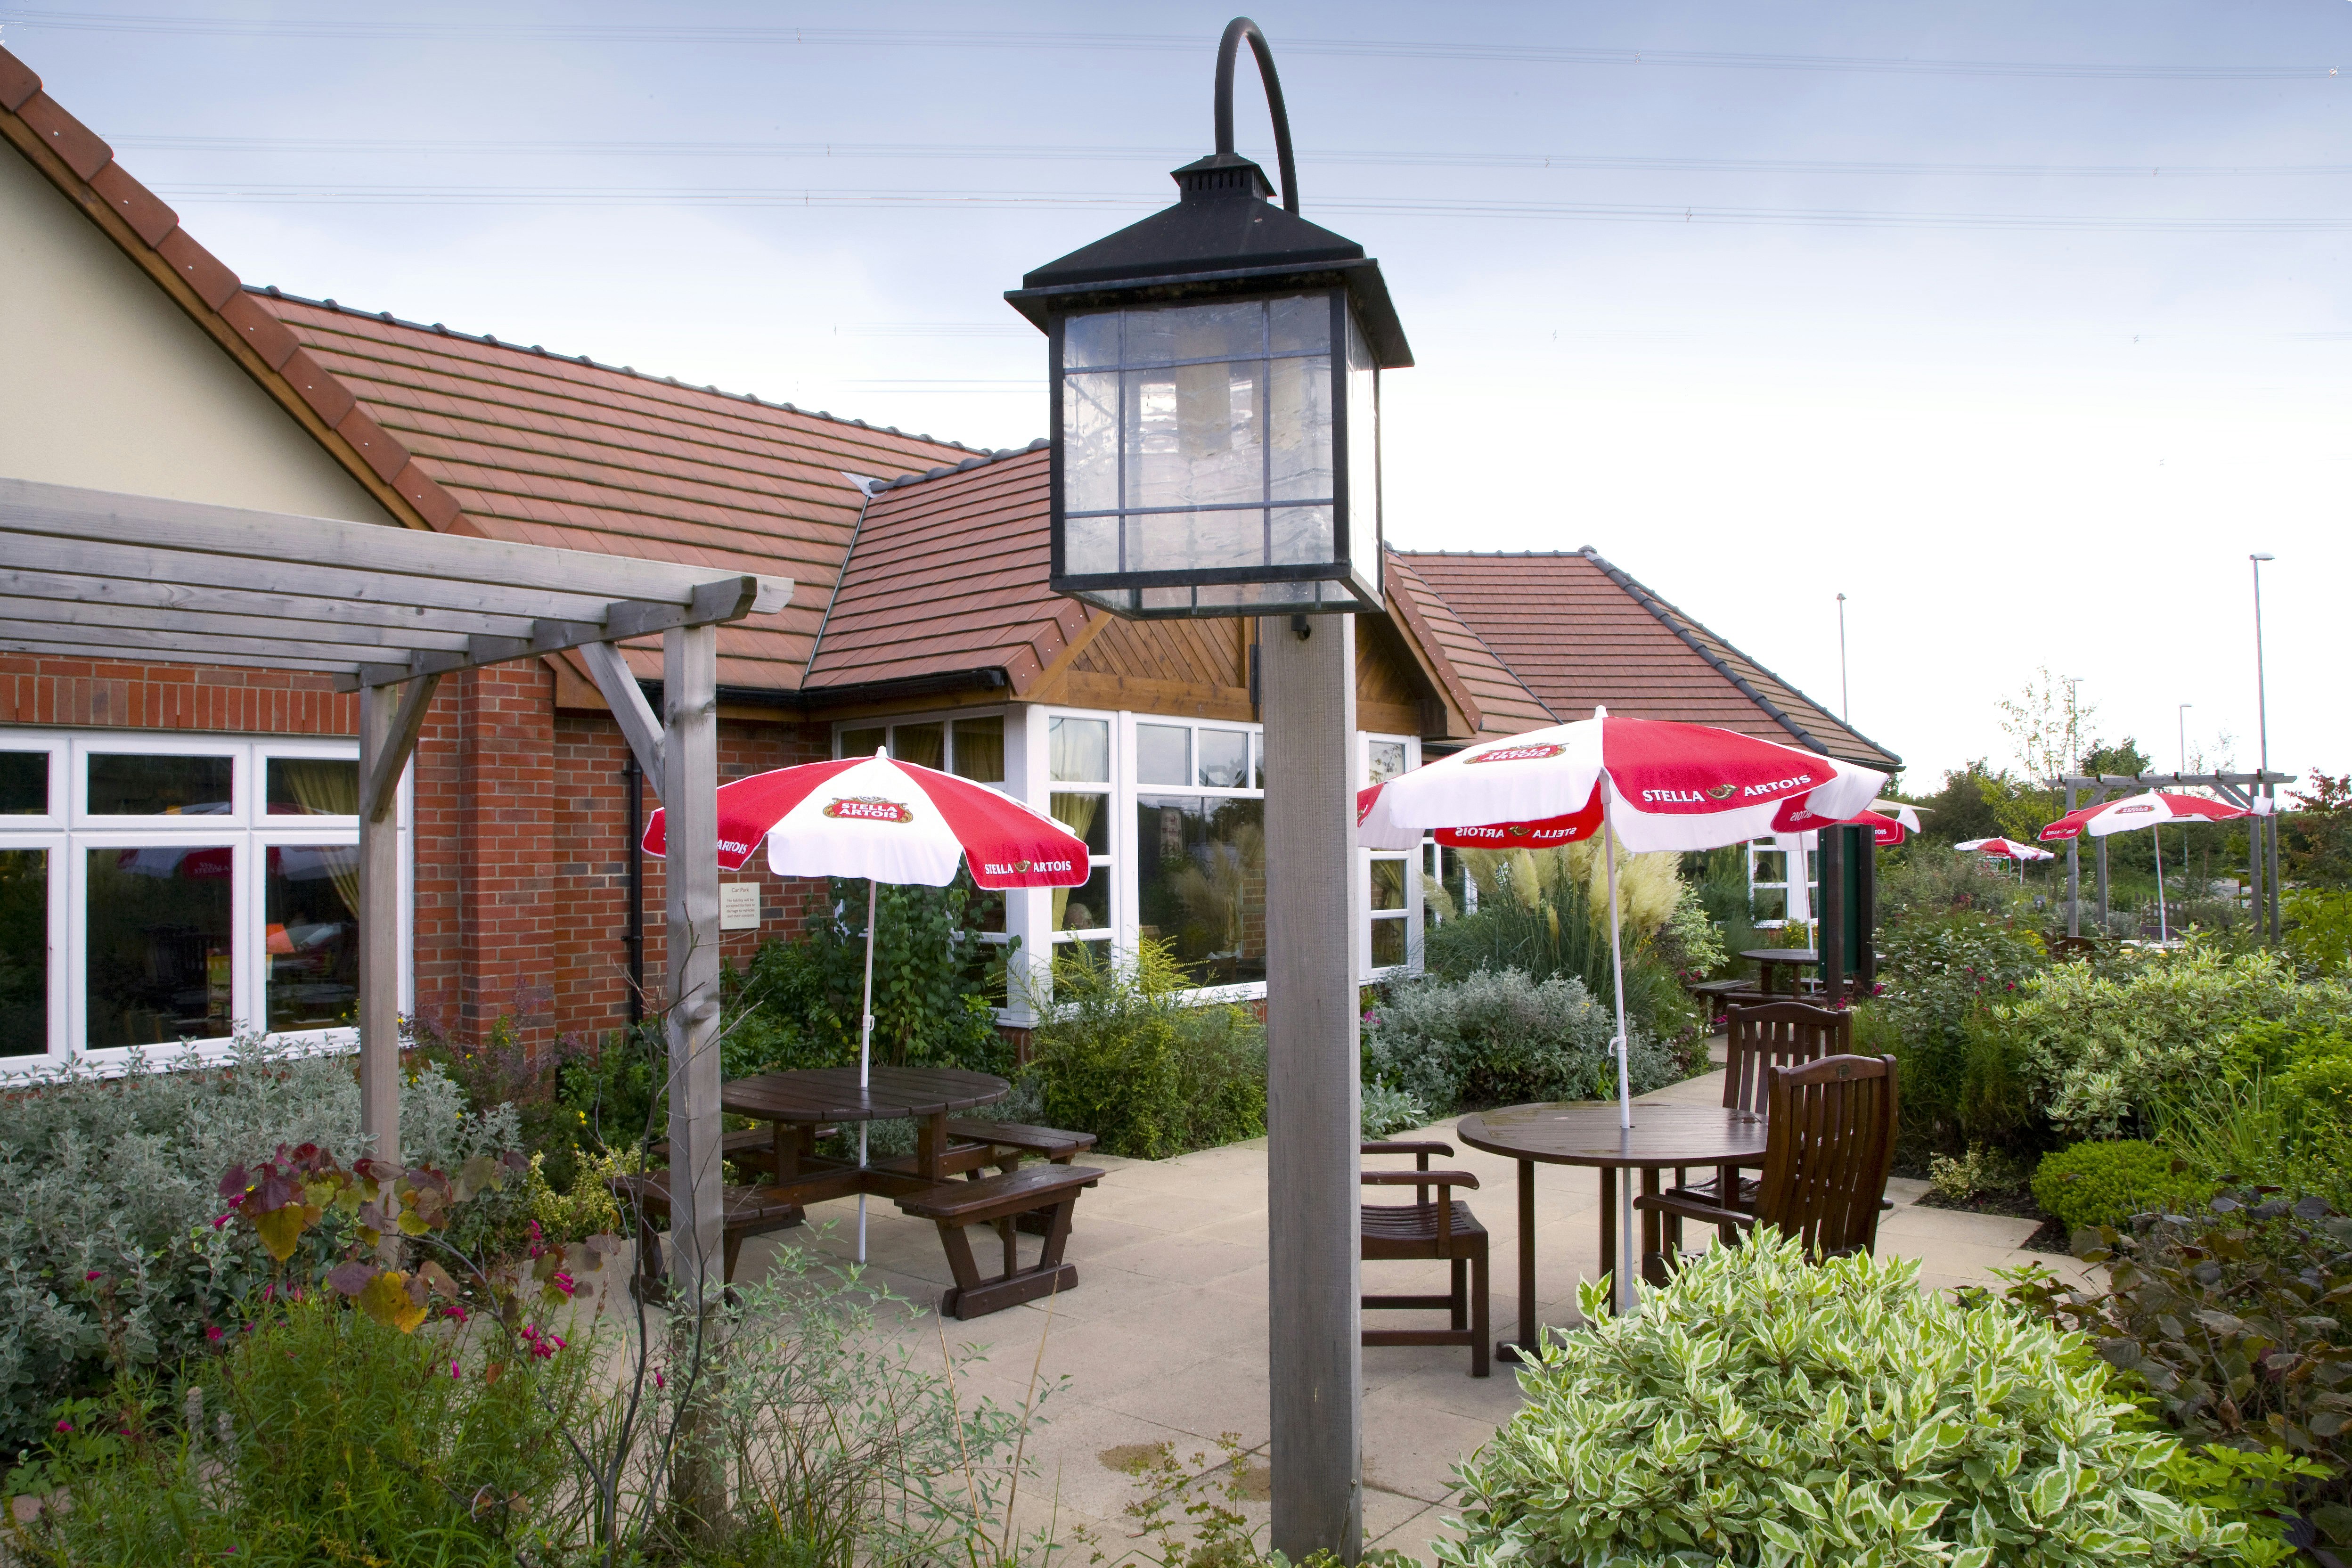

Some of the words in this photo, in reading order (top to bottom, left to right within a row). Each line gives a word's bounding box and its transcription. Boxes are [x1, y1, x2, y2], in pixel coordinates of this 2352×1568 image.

[1481, 751, 1548, 761] ARTOIS
[1491, 747, 1551, 756] STELLA
[1642, 790, 1706, 802] STELLA
[1744, 775, 1811, 797] ARTOIS
[841, 803, 898, 813] STELLA
[839, 809, 898, 818] ARTOIS
[717, 840, 748, 855] ARTOIS
[985, 863, 1014, 874] STELLA
[1033, 860, 1071, 873] ARTOIS
